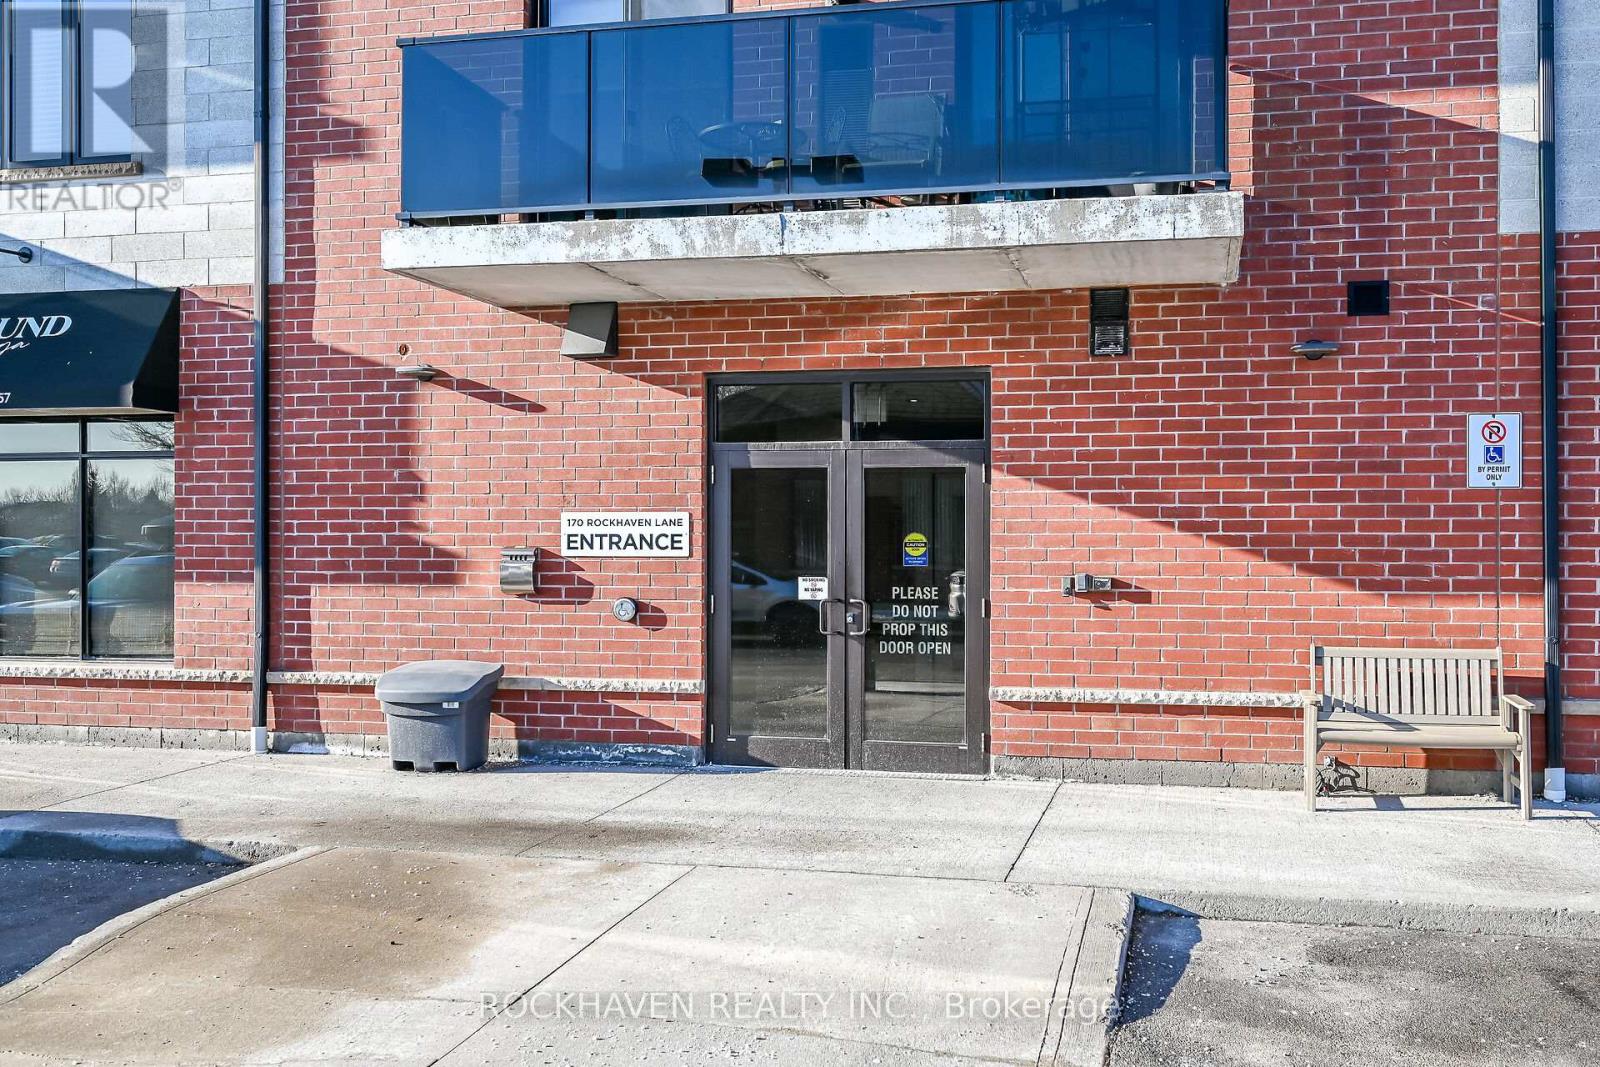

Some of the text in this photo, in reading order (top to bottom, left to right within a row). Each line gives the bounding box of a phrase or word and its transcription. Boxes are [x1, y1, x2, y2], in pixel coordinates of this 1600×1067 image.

[567, 518, 683, 527] 170 ROCKHAVEN LANE
[566, 533, 683, 550] ENTRANCE
[891, 586, 939, 600] PLEASE
[892, 604, 939, 618] DO NOT
[882, 623, 948, 636] PROP THIS
[879, 640, 951, 655] DOOR OPEN
